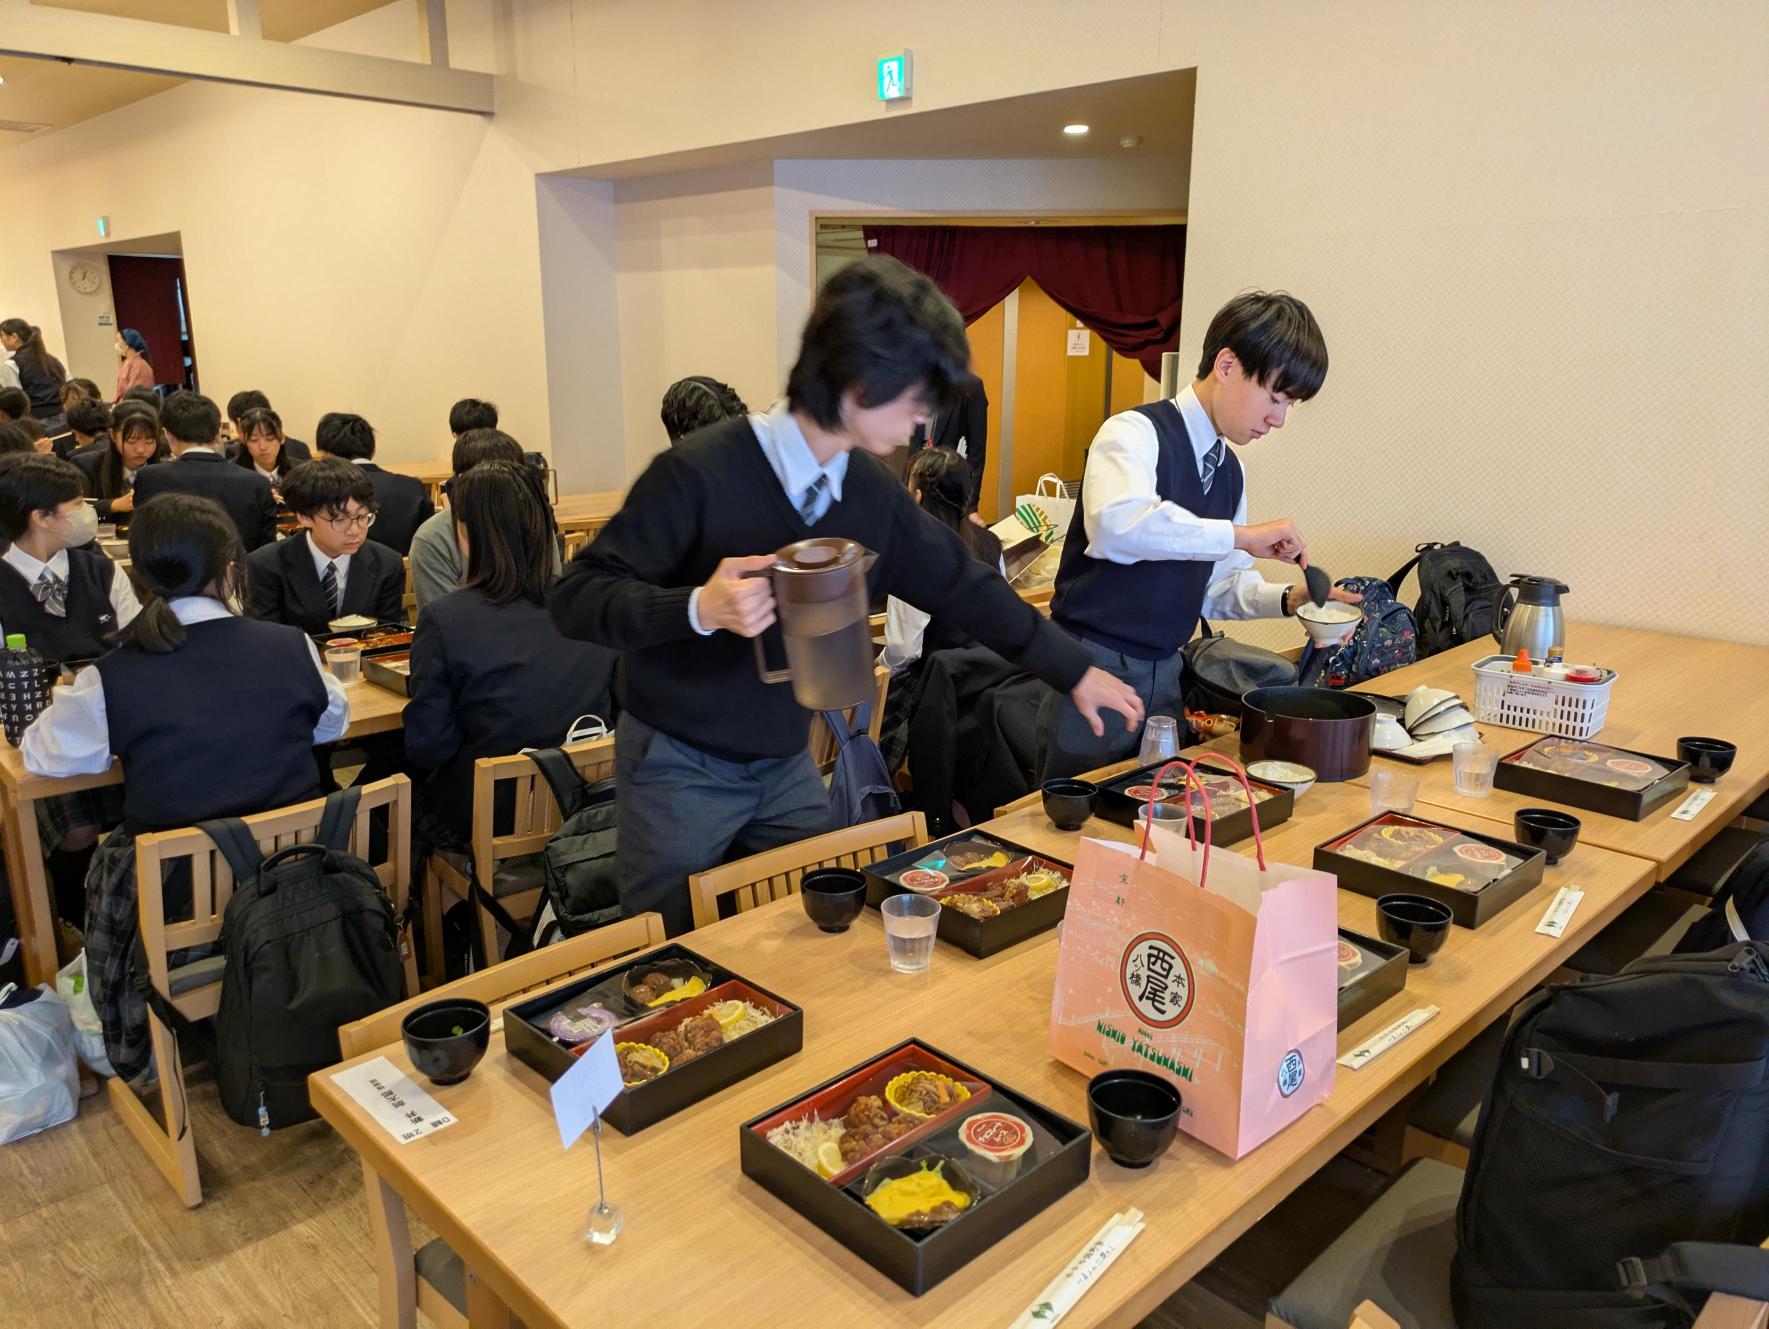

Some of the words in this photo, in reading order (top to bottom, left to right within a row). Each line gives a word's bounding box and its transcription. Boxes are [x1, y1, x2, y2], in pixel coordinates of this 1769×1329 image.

[1138, 944, 1176, 1015] 西尾
[1169, 973, 1186, 1008] 本家
[1096, 1019, 1126, 1045] NISHIO
